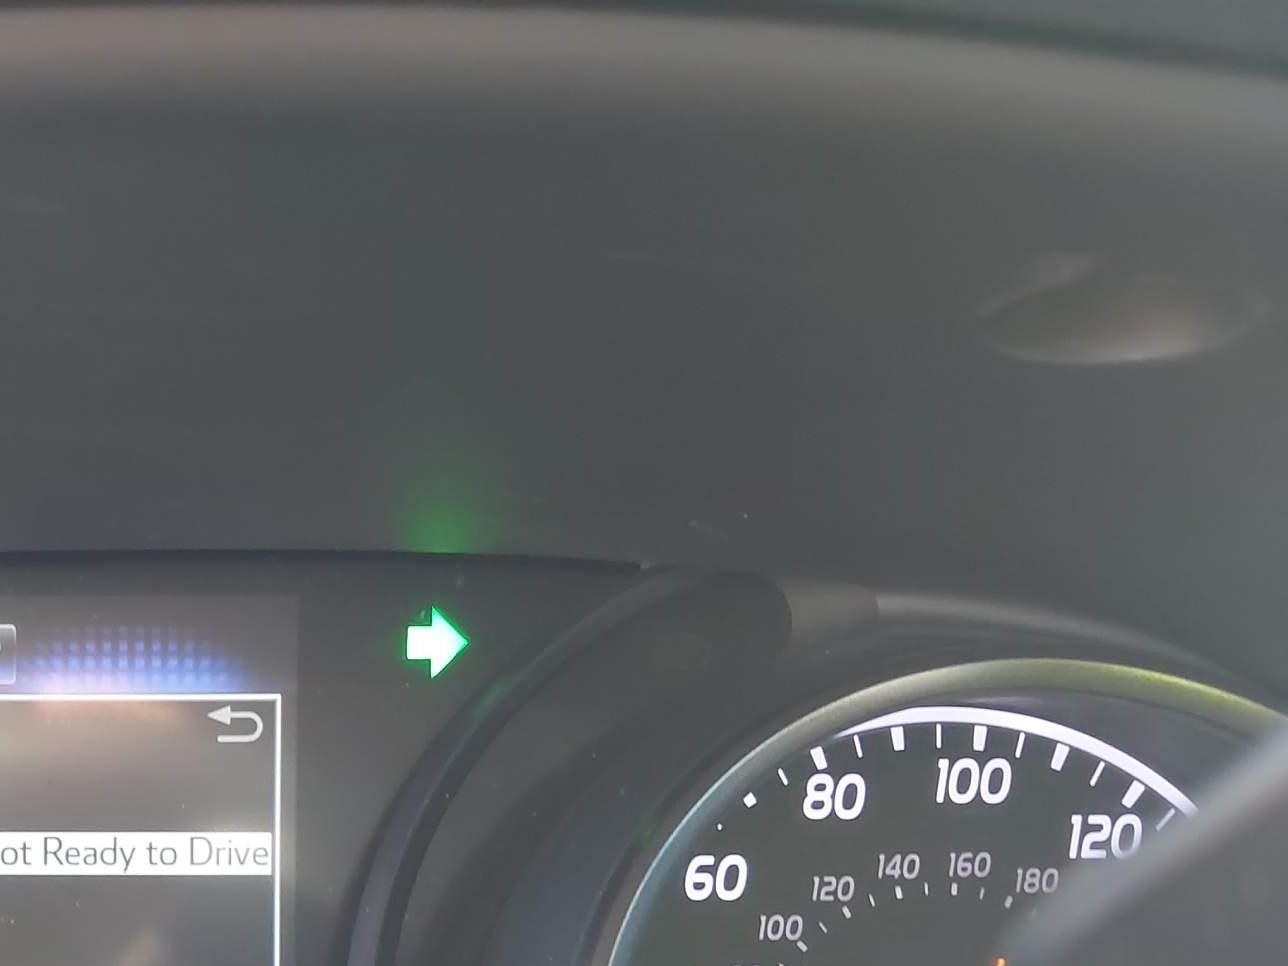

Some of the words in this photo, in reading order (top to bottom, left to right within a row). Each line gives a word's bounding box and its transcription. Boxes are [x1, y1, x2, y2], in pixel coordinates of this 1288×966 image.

[802, 773, 866, 821] 80
[935, 758, 1012, 805] 100
[1068, 813, 1143, 860] 120
[43, 836, 136, 873] Ready
[145, 841, 178, 866] to
[189, 836, 269, 866] Drive
[877, 853, 921, 880] 140
[948, 852, 991, 878] 160
[684, 854, 748, 902] 60
[812, 875, 855, 902] 120
[1015, 867, 1059, 894] 180
[758, 914, 804, 941] 100
